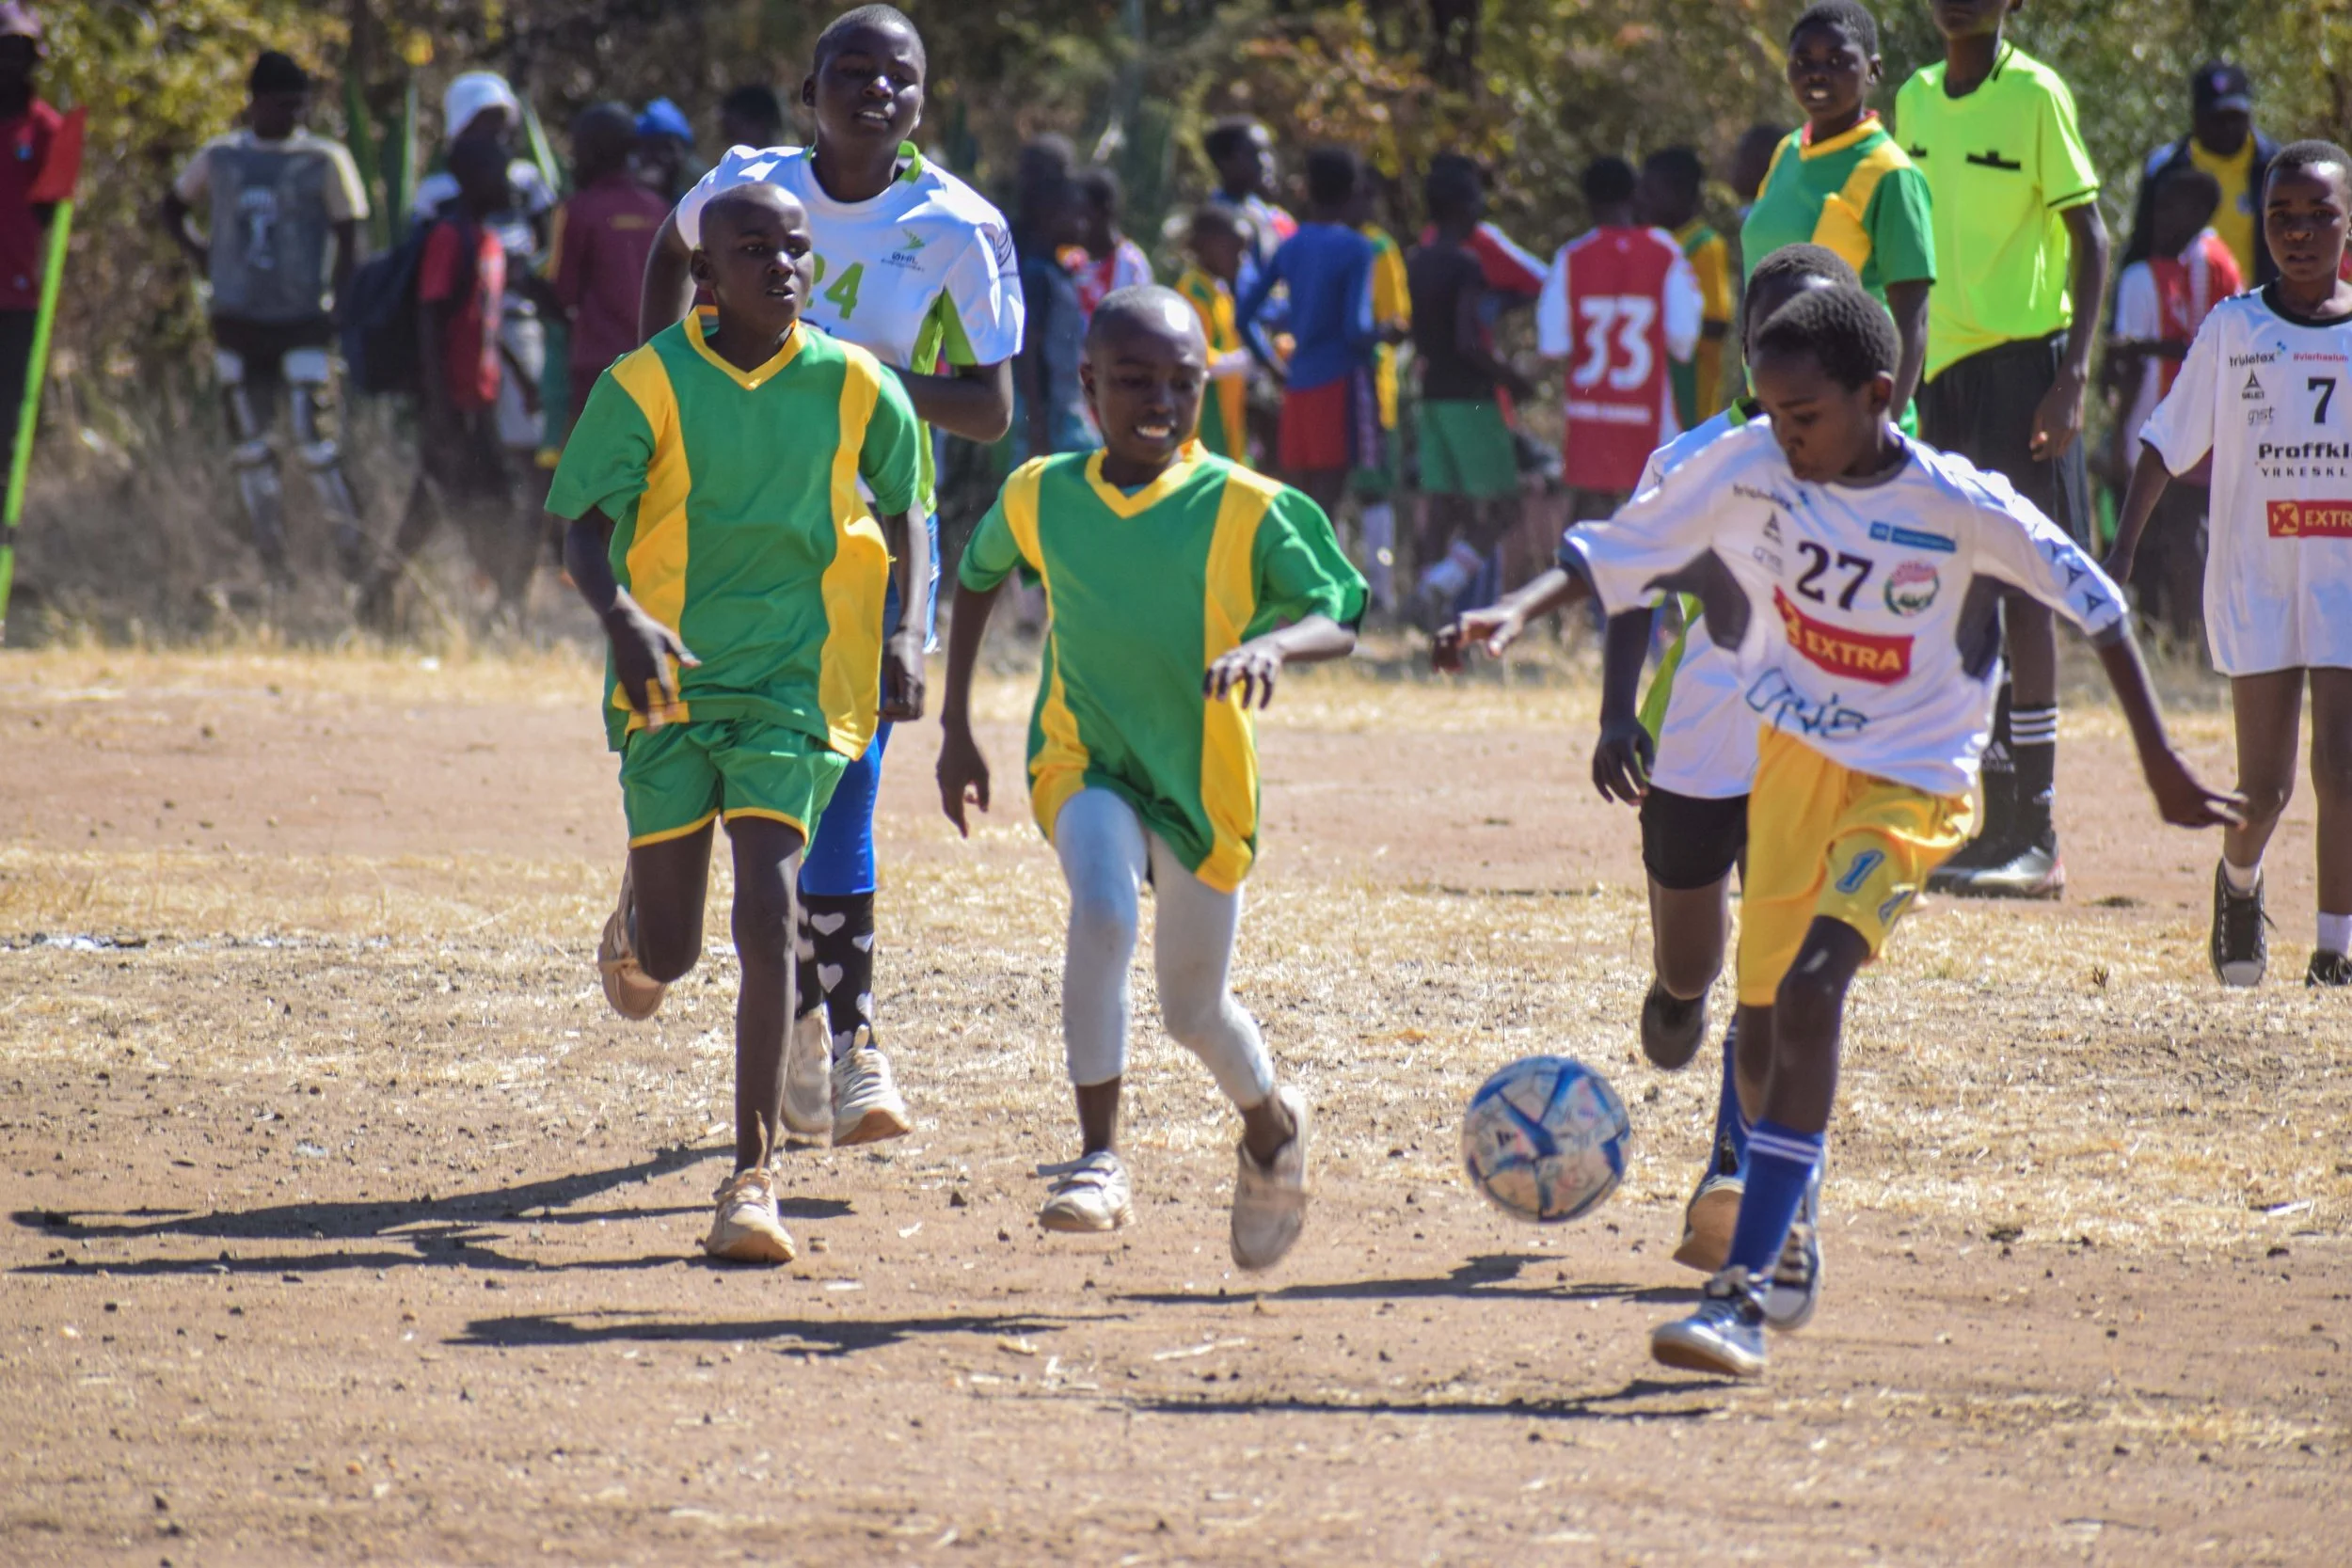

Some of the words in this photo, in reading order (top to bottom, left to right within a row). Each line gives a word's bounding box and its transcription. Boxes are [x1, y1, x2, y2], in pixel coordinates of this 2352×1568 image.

[1573, 295, 1657, 390] 33
[2308, 376, 2337, 424] 7
[2258, 441, 2352, 460] Proffkl
[1797, 540, 1875, 611] 27
[1804, 627, 1902, 672] EXTRA
